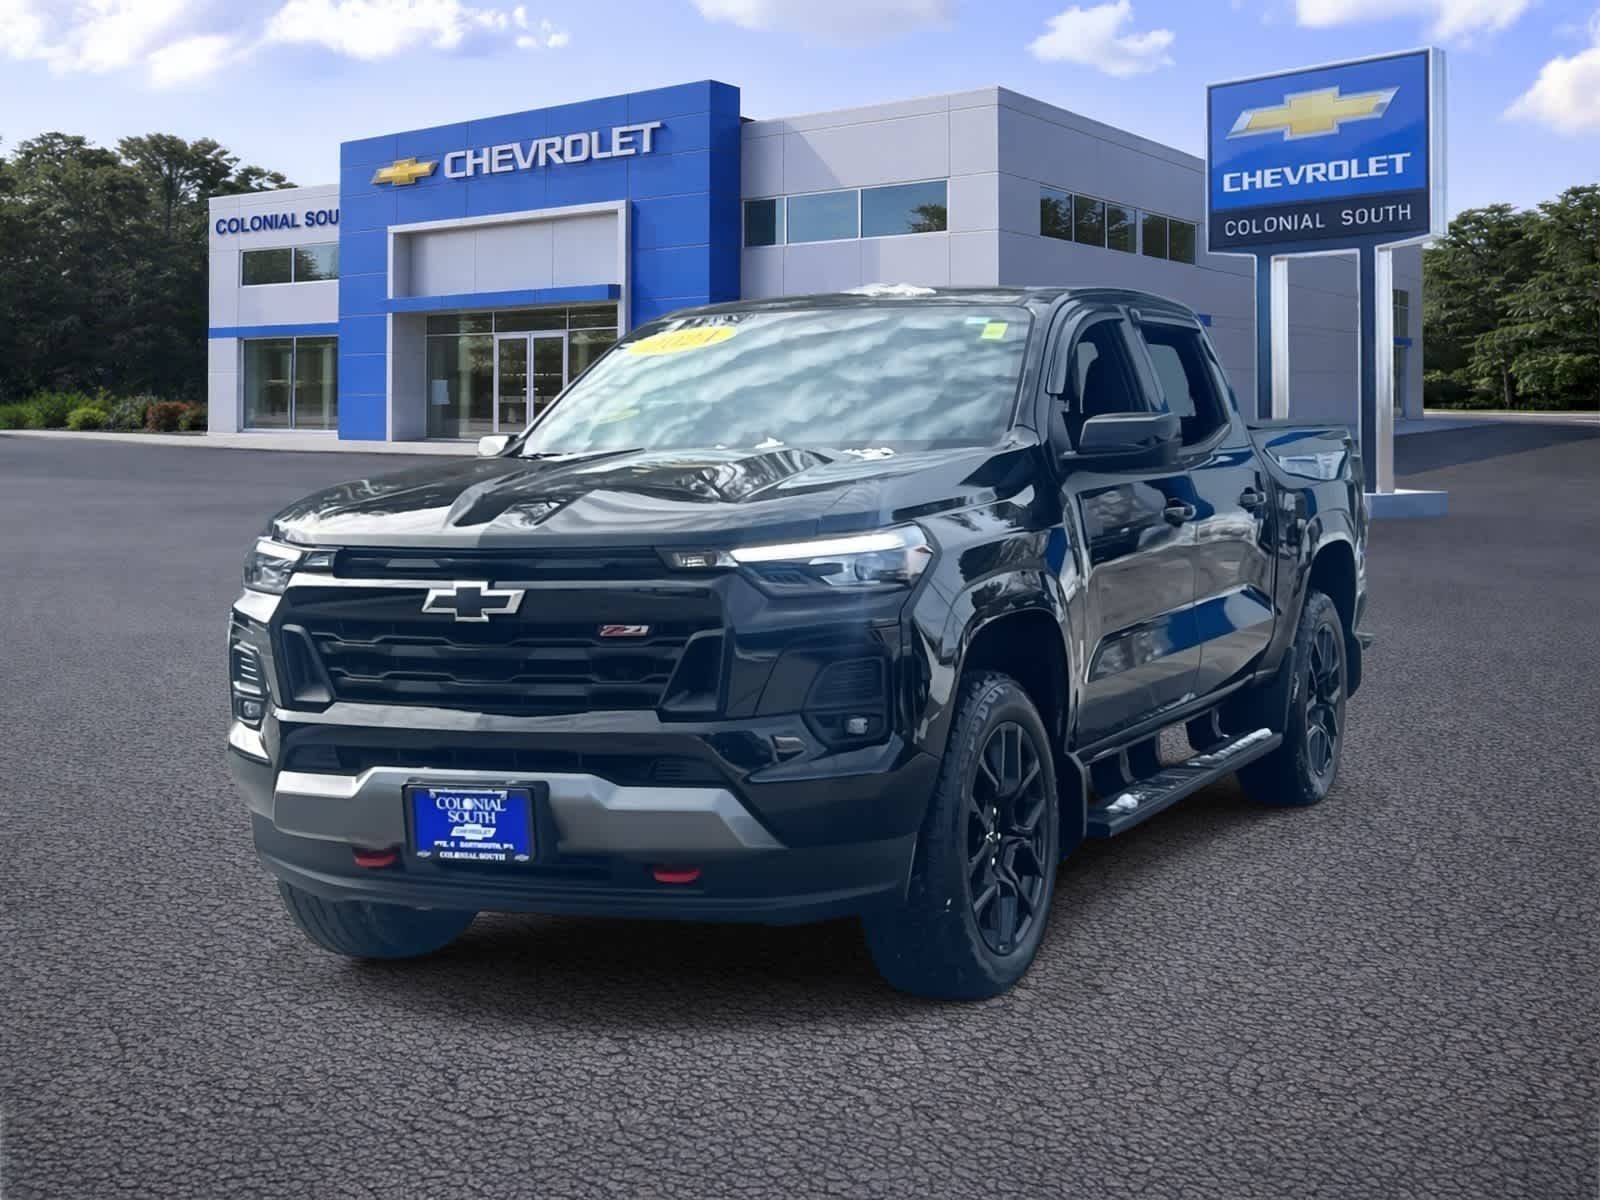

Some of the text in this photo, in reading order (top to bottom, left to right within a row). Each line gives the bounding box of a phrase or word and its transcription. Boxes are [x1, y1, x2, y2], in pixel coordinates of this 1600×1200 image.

[444, 121, 661, 178] CHEVROLET
[1223, 152, 1411, 192] CHEVROLET
[215, 208, 340, 235] COLONIAL SOU
[1225, 203, 1412, 236] COLONIAL SOUTH
[436, 797, 506, 811] COLONIAL
[448, 811, 496, 824] SOUTH
